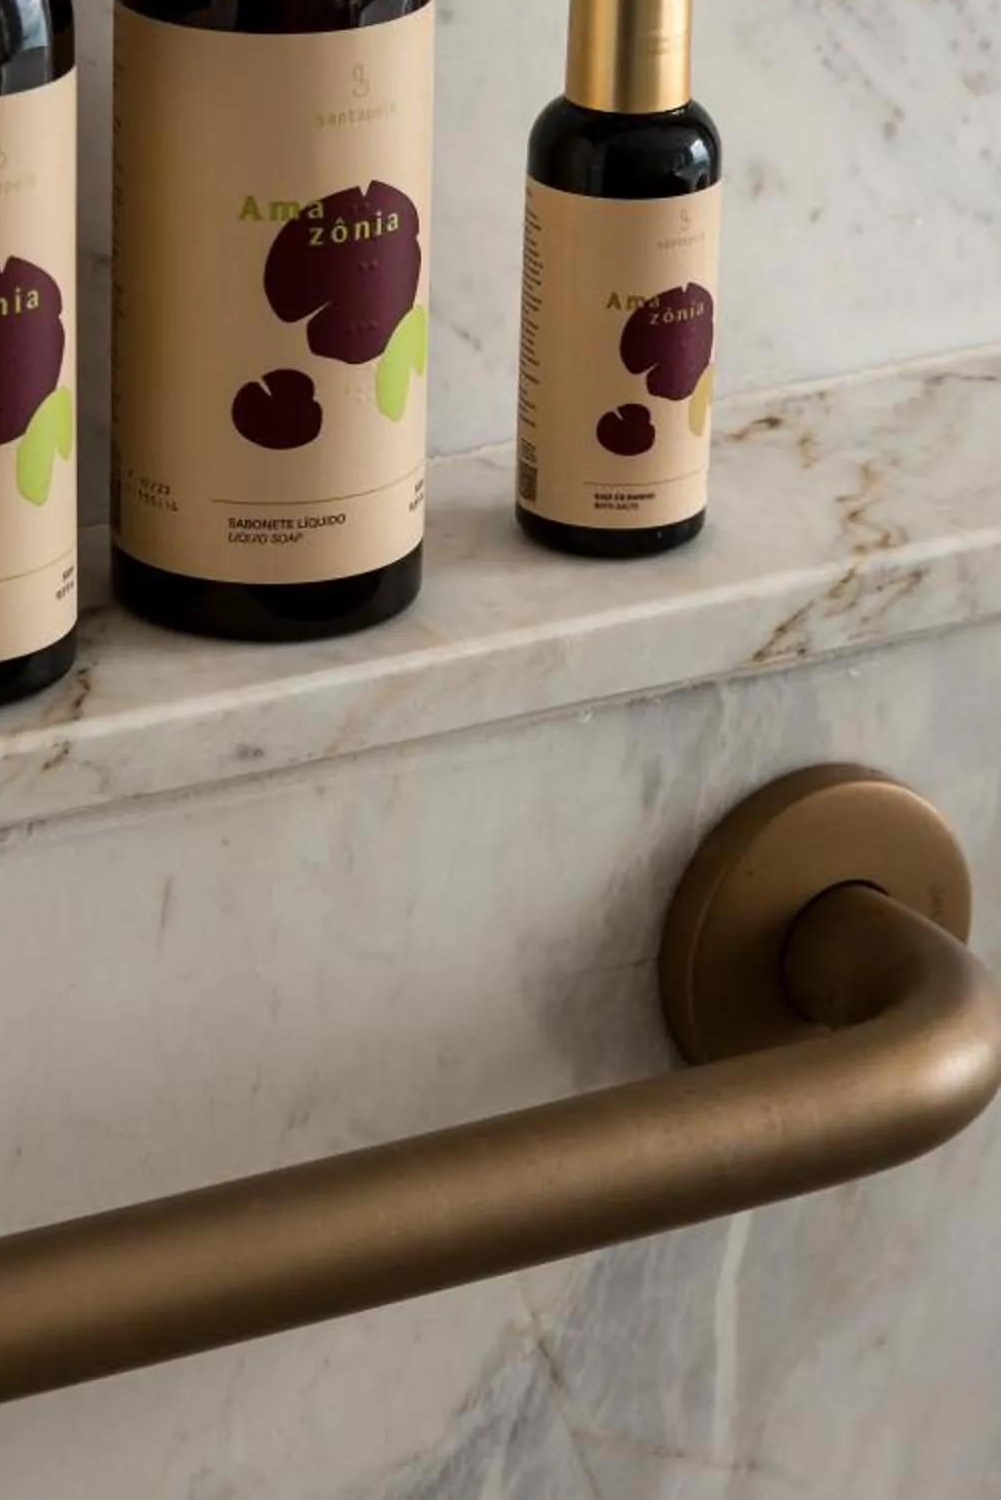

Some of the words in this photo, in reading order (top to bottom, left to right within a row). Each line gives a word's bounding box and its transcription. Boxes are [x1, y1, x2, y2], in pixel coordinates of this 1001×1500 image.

[238, 195, 325, 222] Ama
[308, 211, 400, 247] zônia
[228, 516, 295, 531] SABONETE
[298, 512, 347, 530] LÍQUIDO
[271, 532, 303, 544] SOAP
